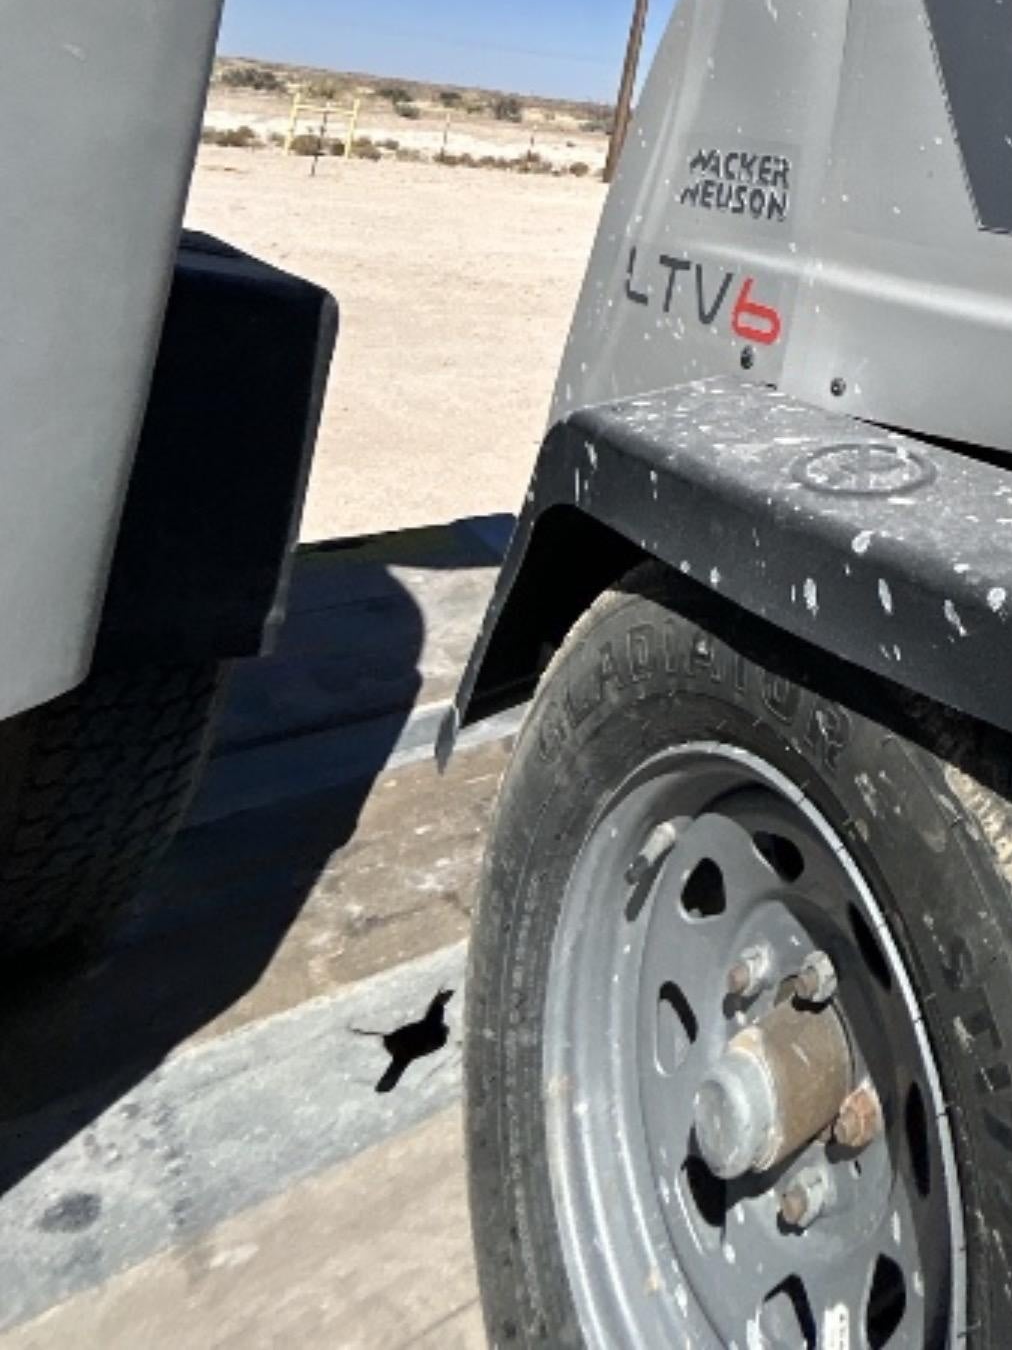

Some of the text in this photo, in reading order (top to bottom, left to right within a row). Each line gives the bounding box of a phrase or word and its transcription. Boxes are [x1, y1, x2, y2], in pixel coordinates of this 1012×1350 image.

[688, 149, 790, 190] WACKER
[679, 179, 788, 223] NEUSON
[625, 245, 782, 347] LTV6
